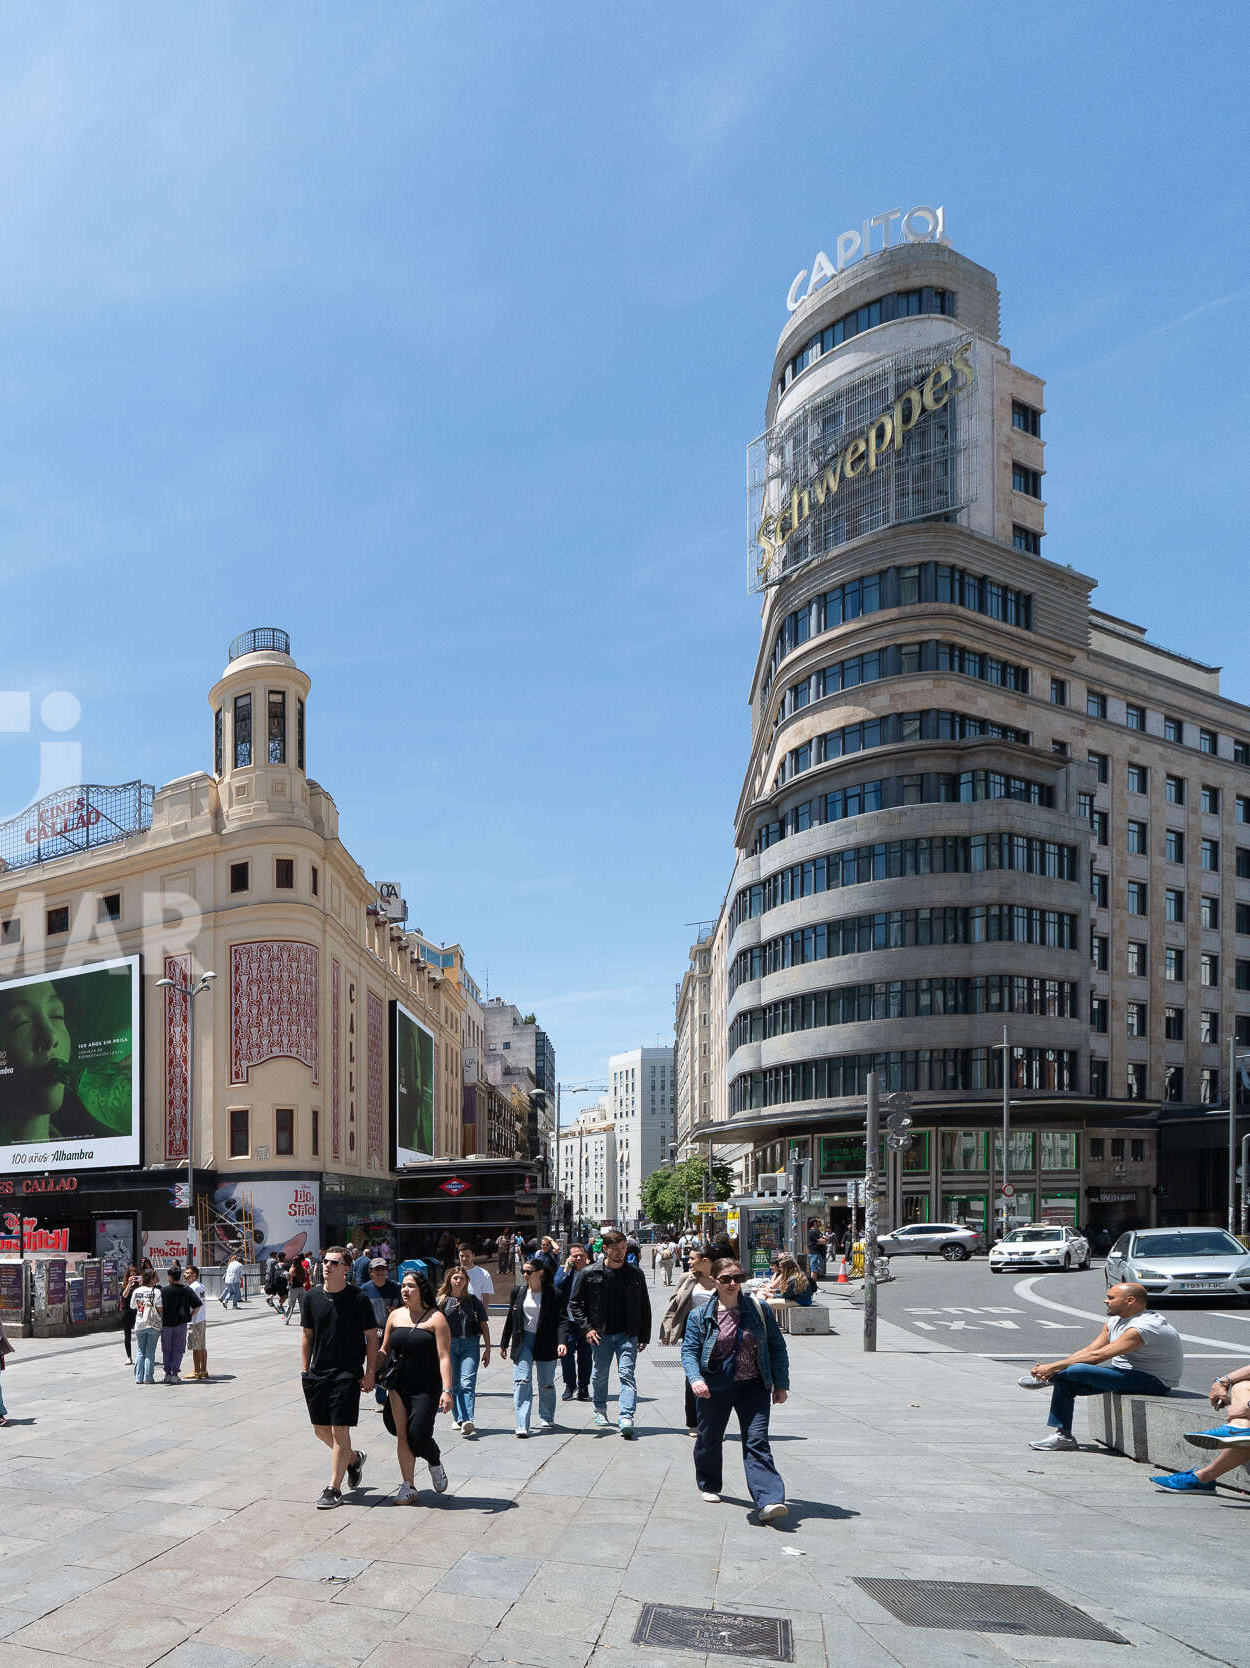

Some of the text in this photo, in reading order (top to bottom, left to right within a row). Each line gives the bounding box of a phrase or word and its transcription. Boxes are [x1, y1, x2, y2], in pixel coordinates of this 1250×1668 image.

[787, 205, 954, 312] CAPITOL
[757, 342, 974, 574] Schweppes
[39, 797, 86, 821] CINES
[25, 807, 101, 845] CALLAO
[12, 1149, 94, 1164] 100 años Alhambra
[22, 1177, 77, 1194] CALLAO
[910, 1318, 1086, 1331] TAXI
